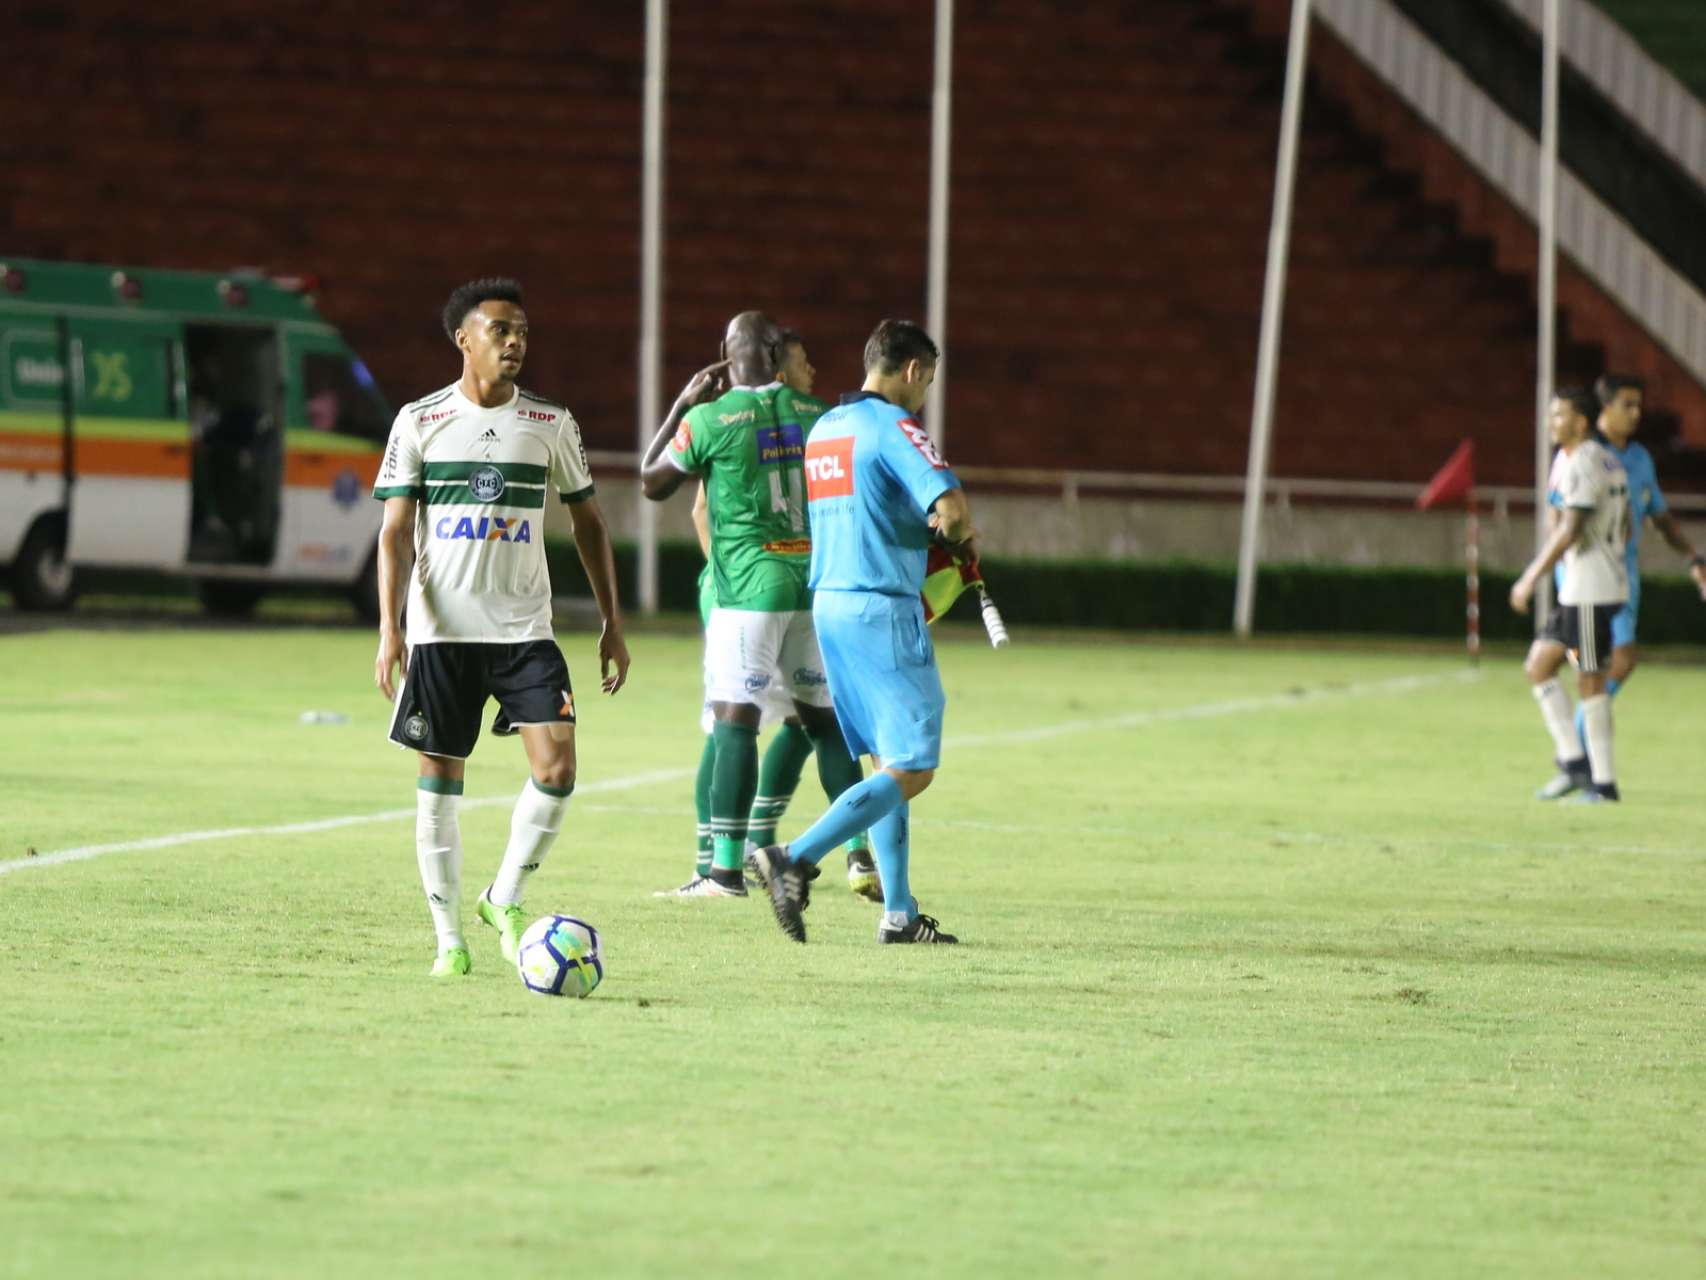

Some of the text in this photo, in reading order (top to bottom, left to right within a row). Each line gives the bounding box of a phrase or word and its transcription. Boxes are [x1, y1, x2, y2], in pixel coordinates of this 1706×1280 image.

[528, 411, 556, 422] RDP
[805, 455, 846, 482] TCL
[435, 516, 531, 544] CAIXA
